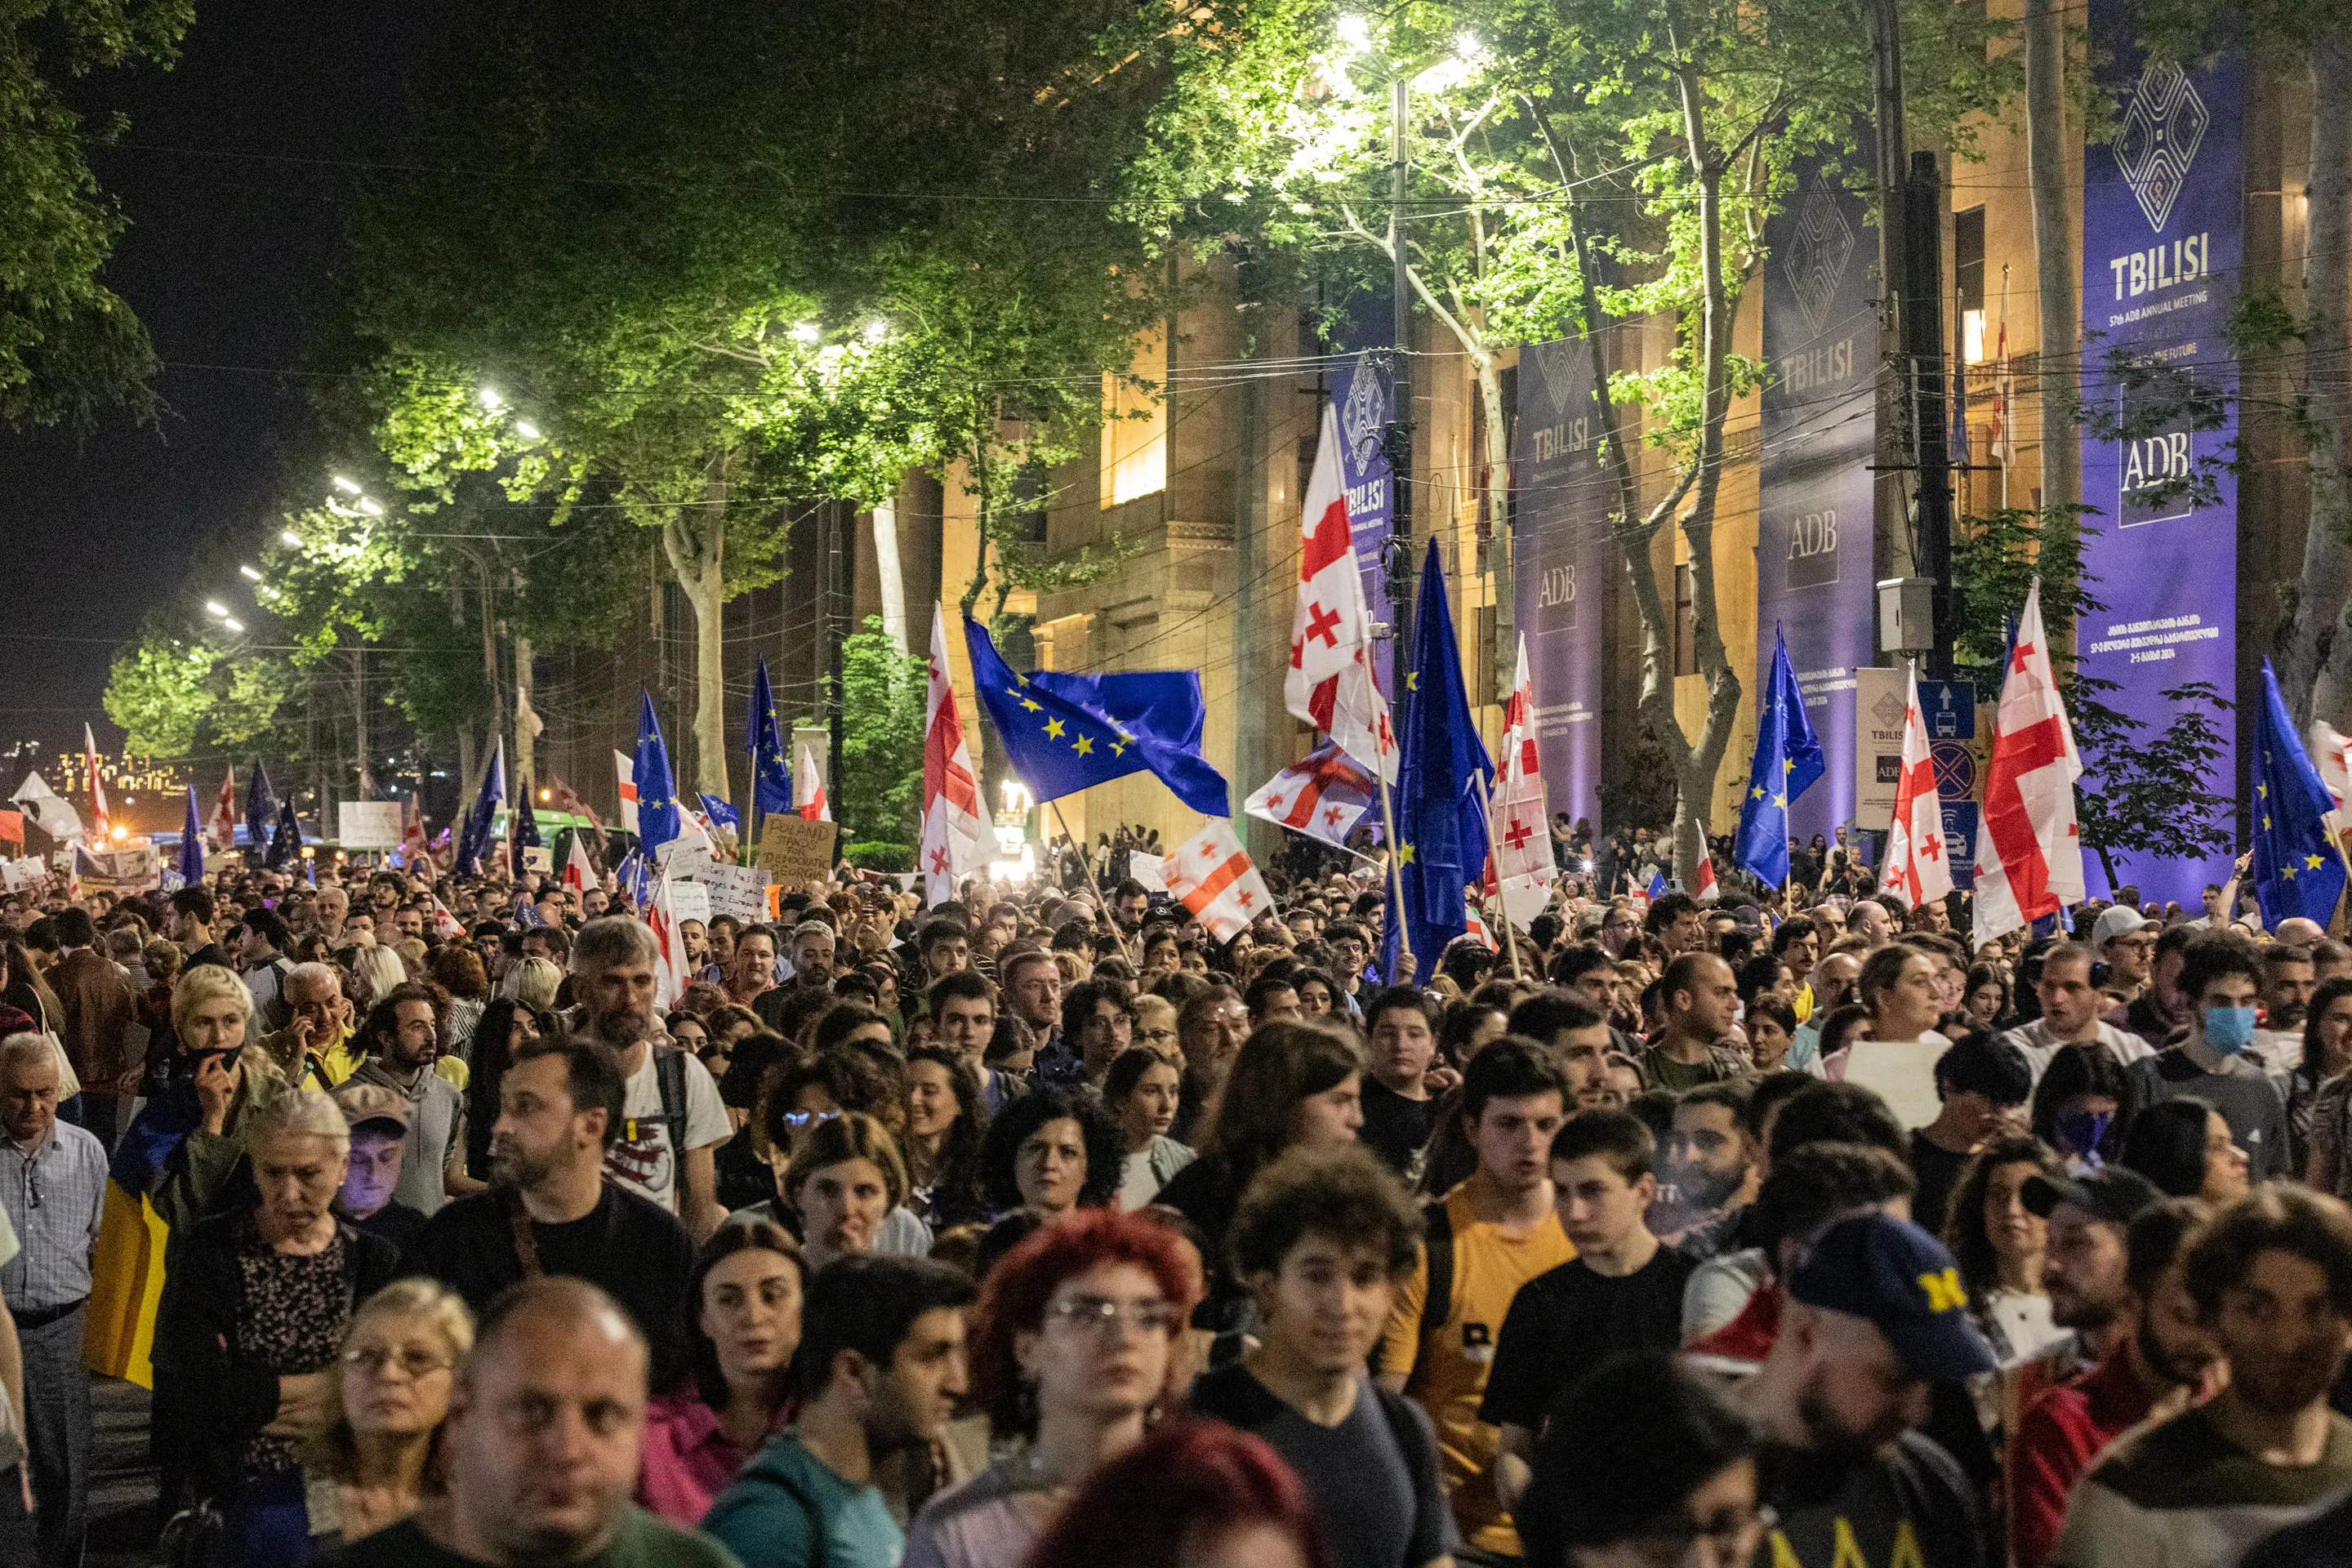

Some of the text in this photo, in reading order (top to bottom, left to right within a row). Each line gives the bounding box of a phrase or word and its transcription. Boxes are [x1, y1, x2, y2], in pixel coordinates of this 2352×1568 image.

[2110, 232, 2208, 301] TBILISI
[2141, 300, 2172, 318] ANNUAL
[2173, 291, 2207, 311] MEETING
[1781, 339, 1853, 394] TBILISI
[2169, 342, 2198, 360] FUTURE
[1533, 416, 1588, 463] TBILISI
[2121, 432, 2189, 492] ADB
[1343, 479, 1384, 516] BILISI
[1788, 510, 1837, 560] ADB
[1538, 564, 1575, 608] ADB
[1872, 731, 1904, 740] TBILIS
[768, 819, 829, 841] POLAND
[776, 835, 817, 850] STANDS
